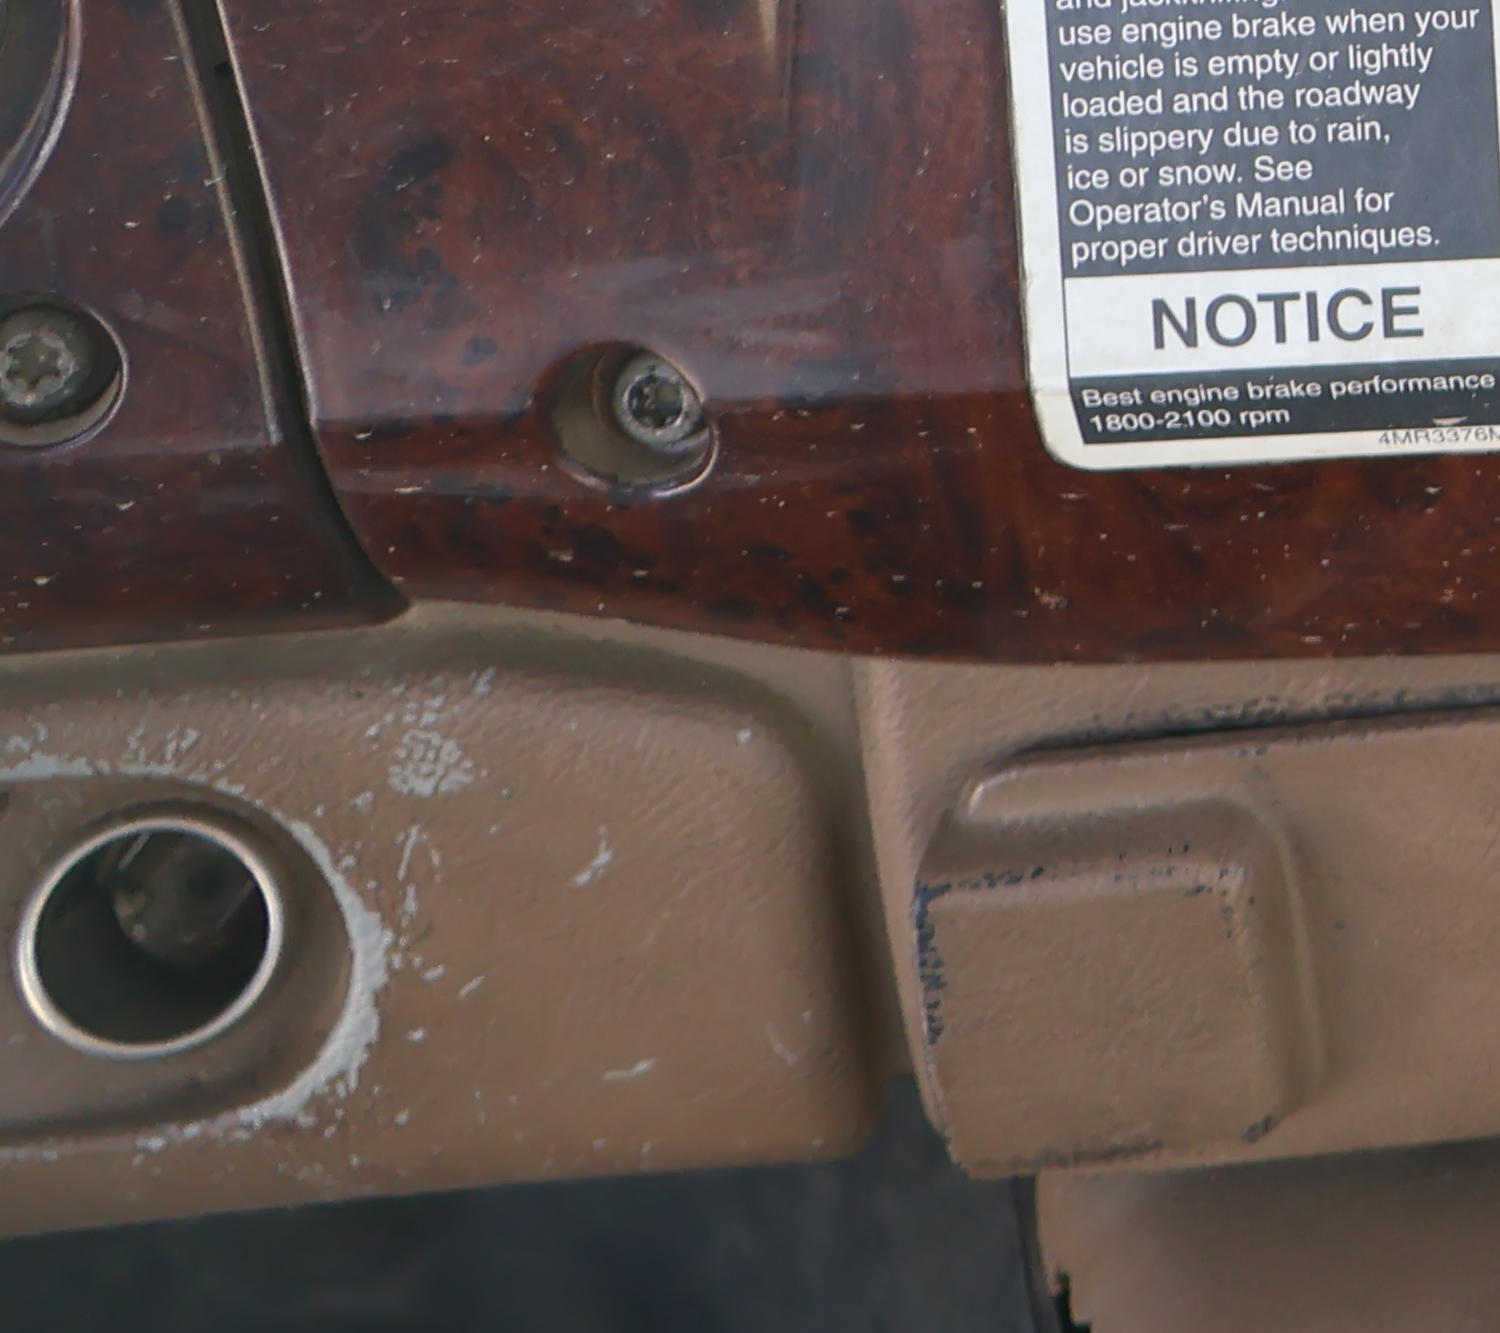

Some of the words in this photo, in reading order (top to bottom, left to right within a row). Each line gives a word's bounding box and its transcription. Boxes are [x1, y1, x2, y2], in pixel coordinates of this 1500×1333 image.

[1058, 24, 1111, 46] use
[1122, 18, 1222, 49] engine
[1231, 11, 1316, 39] brake
[1324, 10, 1405, 36] when
[1414, 7, 1480, 37] your
[1060, 52, 1164, 82] vehicle
[1175, 51, 1198, 77] is
[1207, 49, 1300, 81] empty
[1309, 48, 1340, 71] or
[1347, 43, 1434, 76] lightly
[1062, 89, 1163, 117] loaded
[1173, 86, 1230, 112] and
[1237, 84, 1284, 109] the
[1295, 80, 1420, 113] roadway
[1065, 130, 1089, 154] is
[1099, 126, 1214, 158] slippery
[1224, 122, 1280, 147] due
[1288, 121, 1317, 144] to
[1326, 118, 1391, 145] rain,
[1066, 164, 1110, 190] ice
[1119, 165, 1149, 188] or
[1158, 162, 1243, 186] snow.
[1254, 156, 1313, 182] See
[1236, 191, 1345, 219] Manual
[1354, 189, 1395, 213] for
[1071, 238, 1168, 270] proper
[1178, 230, 1260, 257] driver
[1270, 223, 1440, 257] techniques.
[1151, 286, 1425, 349] NOTICE
[1081, 388, 1144, 409] Best
[1153, 383, 1240, 408] engine
[1247, 378, 1322, 399] brake
[1330, 373, 1497, 399] performance
[1090, 408, 1230, 432] 1800-2100
[1239, 407, 1291, 428] rpm
